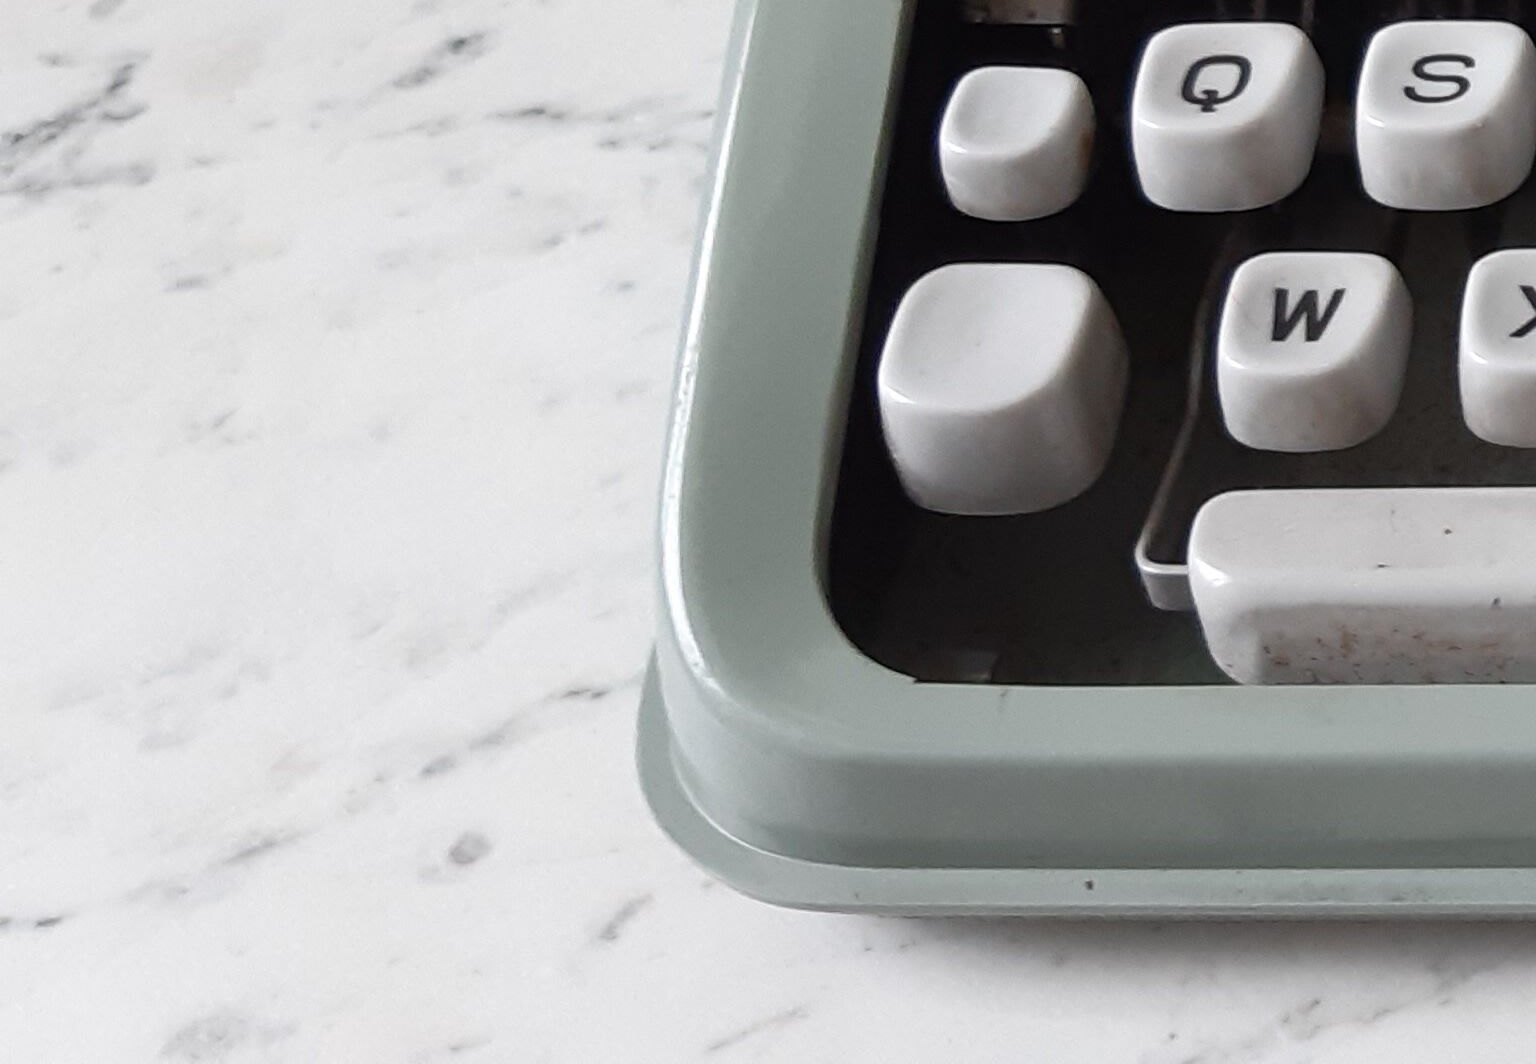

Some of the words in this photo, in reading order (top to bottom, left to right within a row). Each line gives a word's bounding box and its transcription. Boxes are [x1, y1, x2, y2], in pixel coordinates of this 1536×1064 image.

[1181, 55, 1251, 112] Q
[1403, 54, 1475, 103] S
[1271, 288, 1345, 342] W
